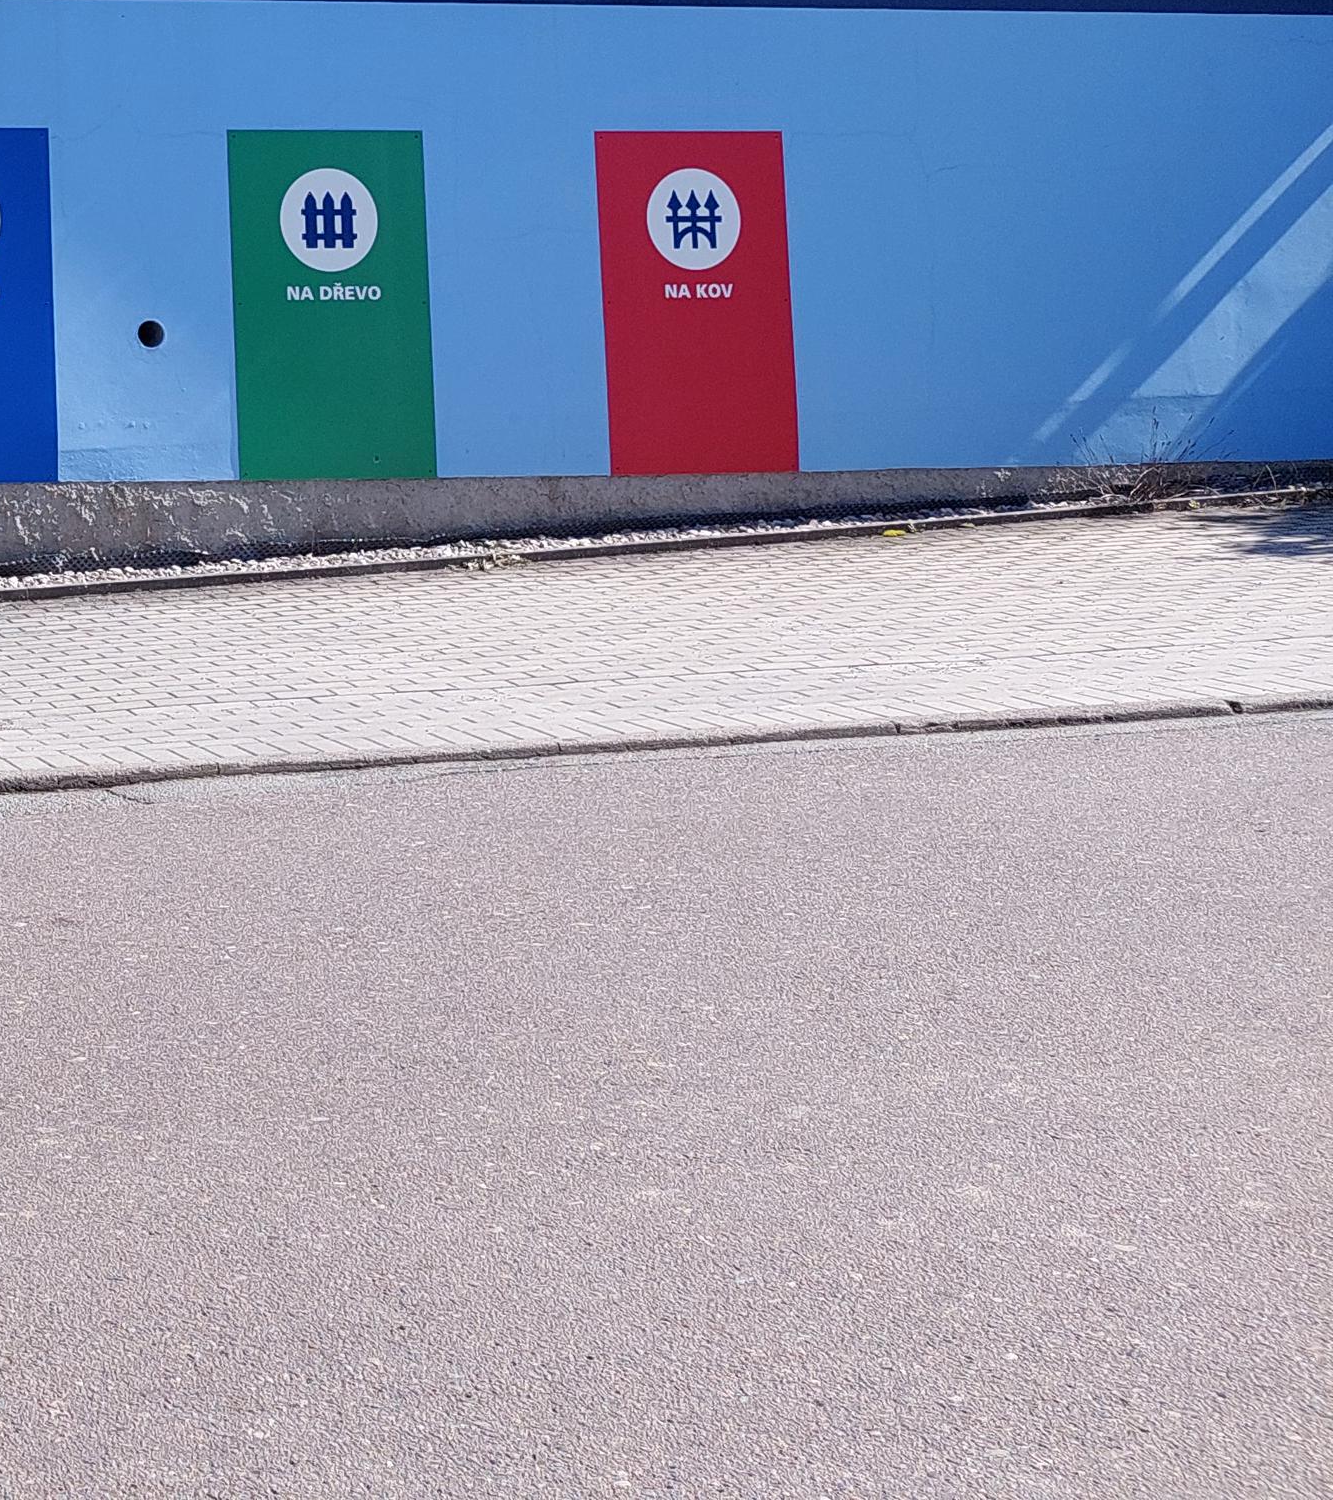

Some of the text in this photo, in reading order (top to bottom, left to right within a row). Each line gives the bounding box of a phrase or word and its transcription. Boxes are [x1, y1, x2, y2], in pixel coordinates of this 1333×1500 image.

[286, 282, 381, 301] NA DŘEVO
[664, 283, 733, 299] NA KOV
